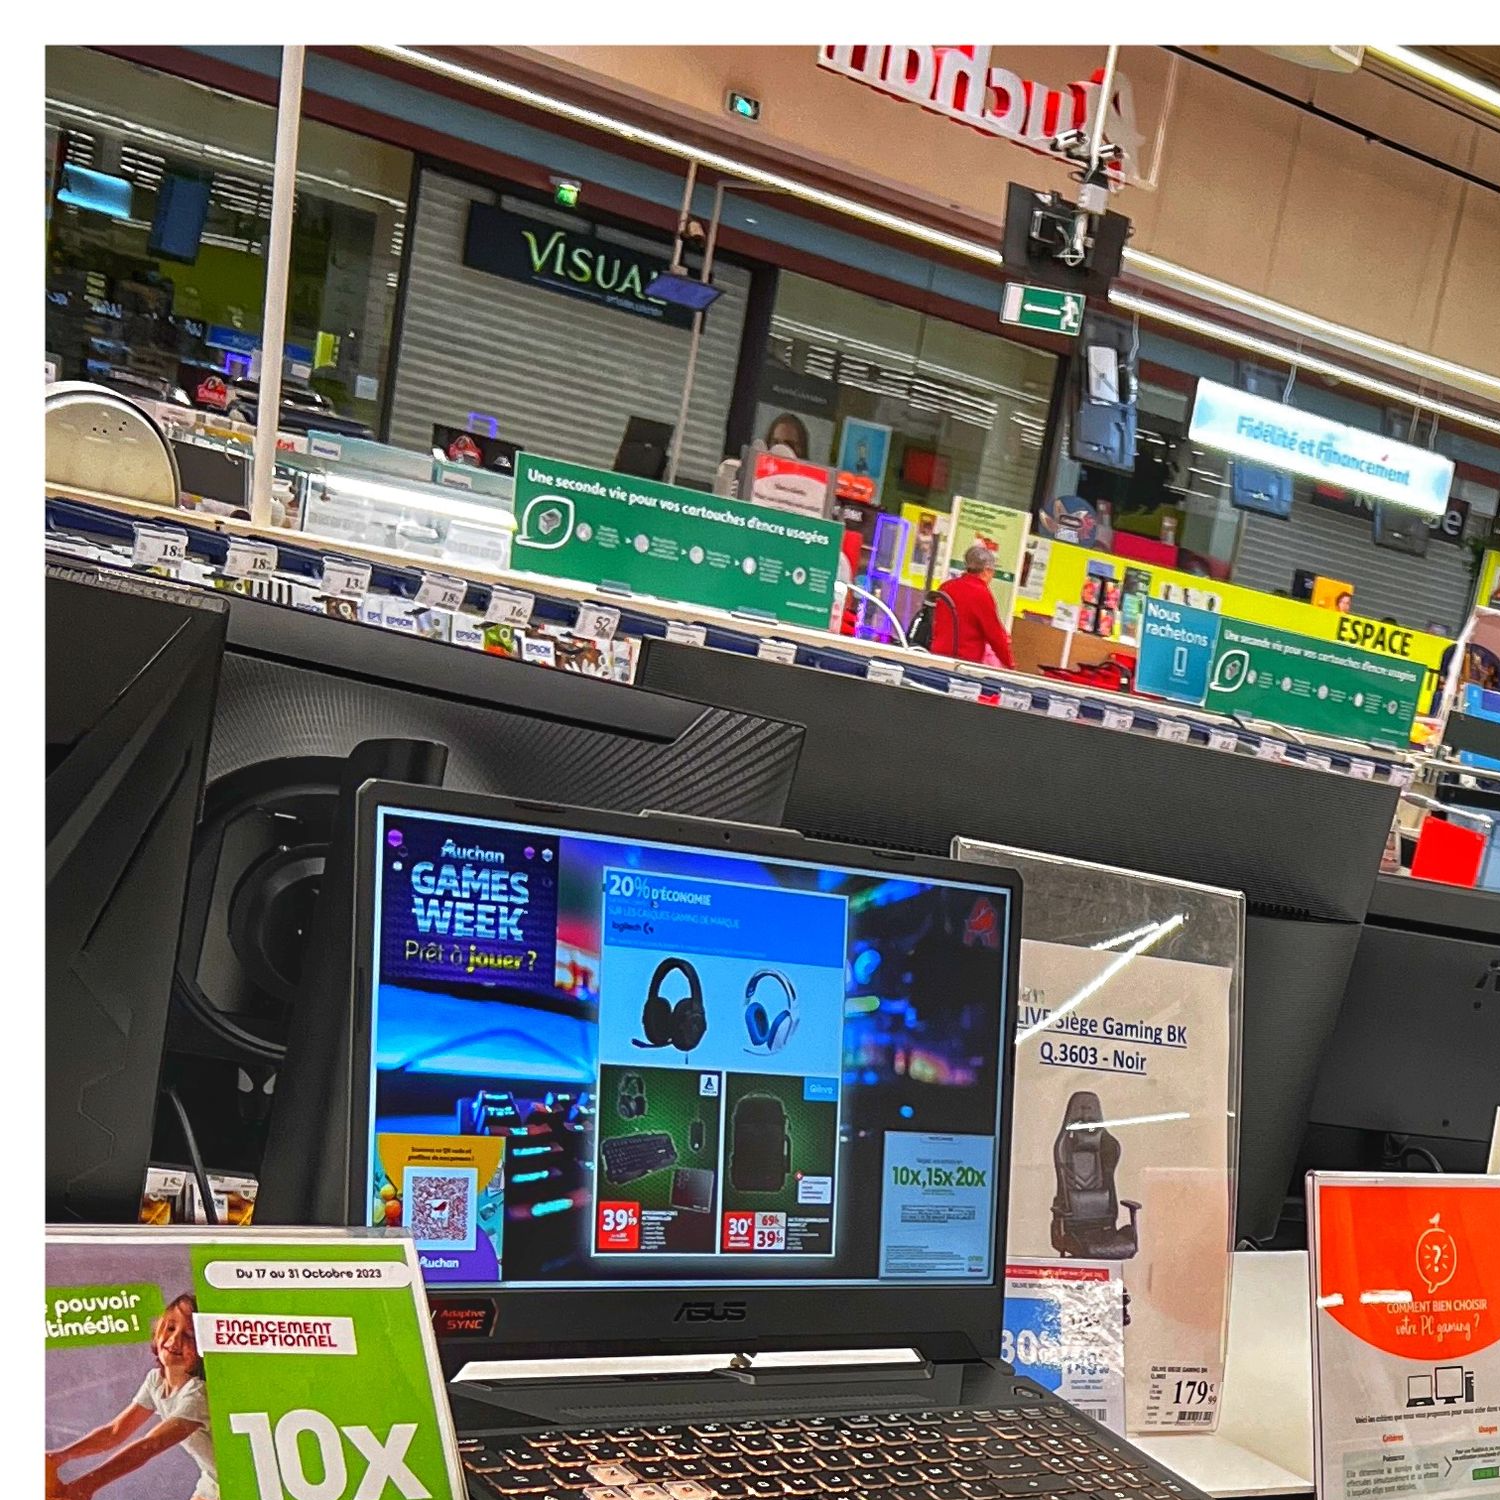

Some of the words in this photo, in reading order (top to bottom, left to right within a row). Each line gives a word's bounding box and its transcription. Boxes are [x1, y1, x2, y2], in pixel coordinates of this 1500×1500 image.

[1236, 415, 1298, 450] Fidélité
[1299, 434, 1315, 455] et
[528, 468, 552, 488] Une
[555, 476, 607, 499] seconde
[609, 486, 628, 501] vie
[628, 491, 657, 509] pour
[659, 498, 680, 513] vos
[682, 503, 745, 528] cartouches
[747, 515, 785, 536] d'encre
[786, 525, 829, 546] usagées
[1148, 602, 1181, 623] Nous
[1146, 621, 1208, 647] rachetons
[1336, 616, 1413, 657] ESPACE
[441, 838, 505, 864] Auchan
[411, 861, 529, 904] GAMES
[609, 874, 650, 899] 20%
[651, 888, 711, 906] D'ÉCONOMIE
[412, 896, 525, 941] WEEK
[405, 939, 445, 963] Prêt
[450, 945, 463, 965] à
[466, 945, 523, 973] jouer
[1103, 1017, 1162, 1044] Gaming
[1167, 1025, 1187, 1044] BK
[1040, 1042, 1098, 1065] Q.3603
[1113, 1050, 1147, 1070] Noir
[236, 1269, 251, 1279] Du
[254, 1269, 266, 1279] 17
[269, 1269, 285, 1279] au
[288, 1269, 300, 1280] 31
[302, 1268, 353, 1279] Octobre
[356, 1268, 382, 1279] 2023
[419, 1256, 459, 1269] Auchan
[54, 1290, 141, 1317] pouvoir
[673, 1301, 747, 1322] ASUS
[1387, 1299, 1431, 1314] COMMENT
[1432, 1299, 1452, 1312] BIEN
[1454, 1298, 1487, 1311] CHOISIR
[215, 1332, 338, 1348] EXCEPTIONNEL
[216, 1319, 332, 1336] FINANCEMENT
[1396, 1315, 1417, 1336] votre
[1421, 1315, 1434, 1335] PC
[1437, 1322, 1470, 1342] gaming
